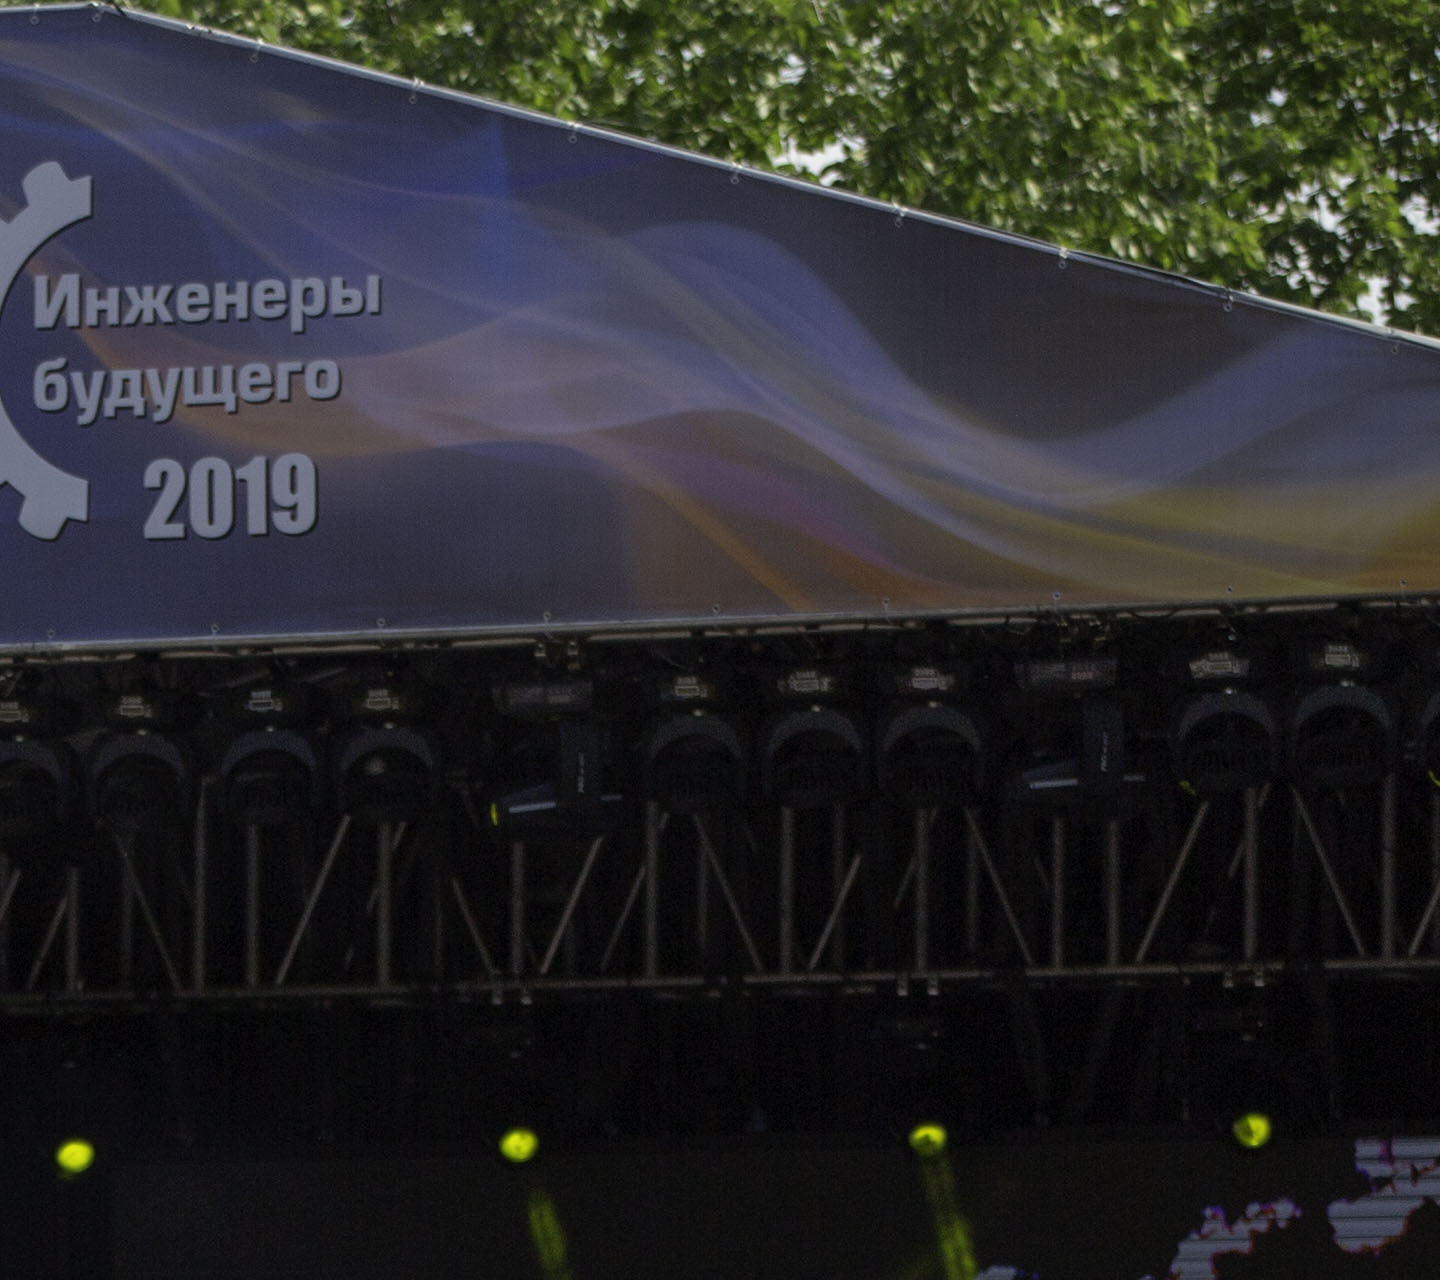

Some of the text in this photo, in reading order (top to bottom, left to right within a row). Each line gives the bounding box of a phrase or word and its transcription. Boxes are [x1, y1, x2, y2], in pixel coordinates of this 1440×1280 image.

[32, 273, 381, 333] Инженеры
[32, 355, 341, 426] будущего
[142, 453, 318, 541] 2019
